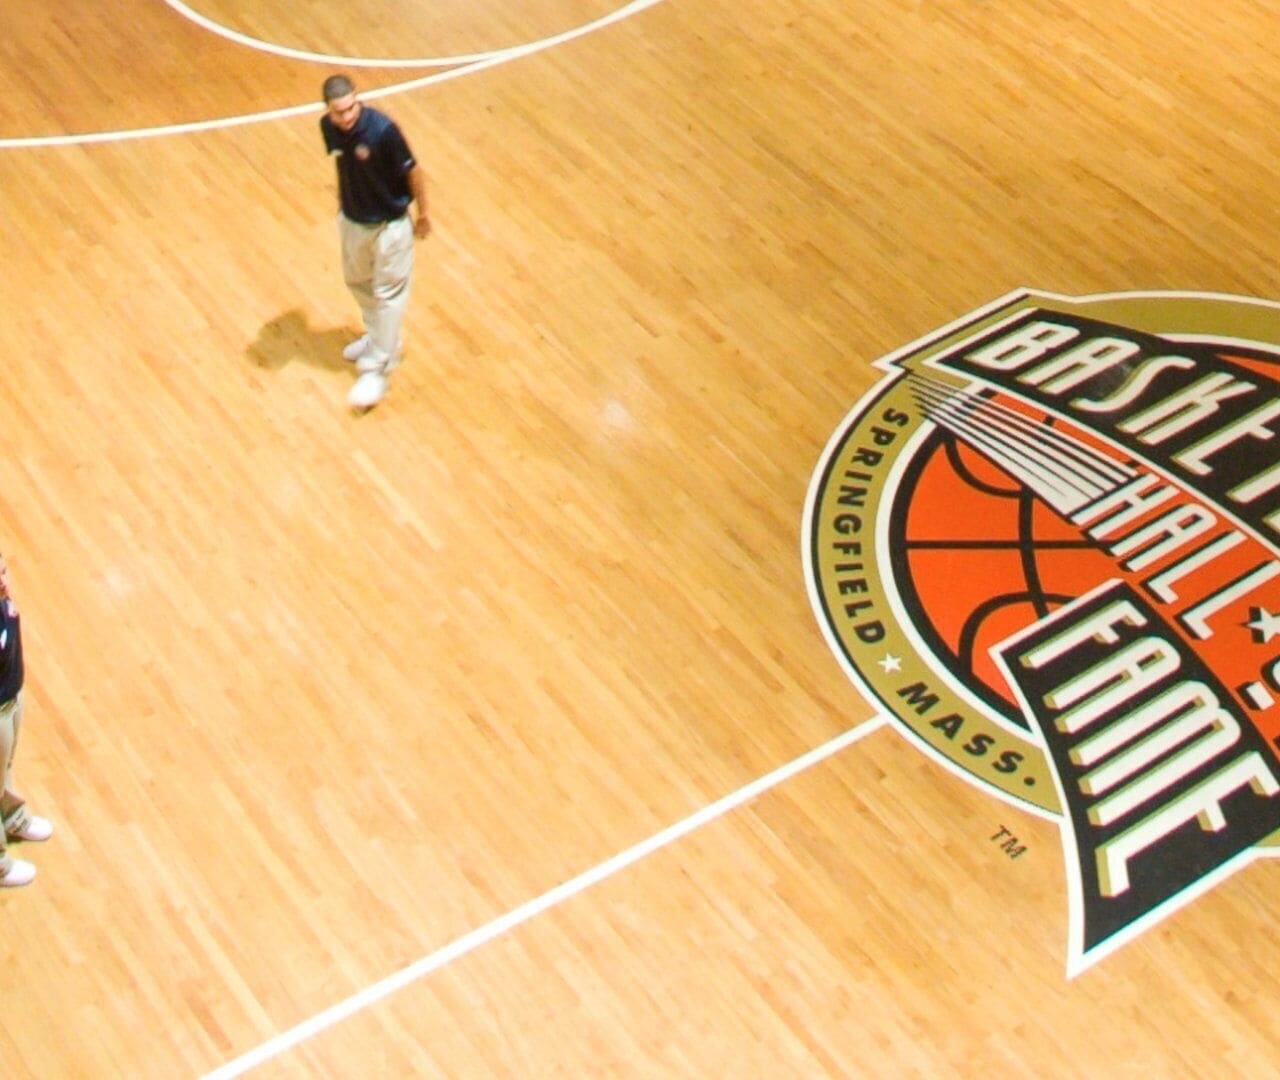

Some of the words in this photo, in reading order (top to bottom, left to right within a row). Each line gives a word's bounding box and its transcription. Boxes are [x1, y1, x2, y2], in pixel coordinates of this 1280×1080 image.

[827, 404, 911, 649] SPRINGFIELD
[896, 679, 1039, 791] MASS.
[988, 823, 1032, 862] TM
